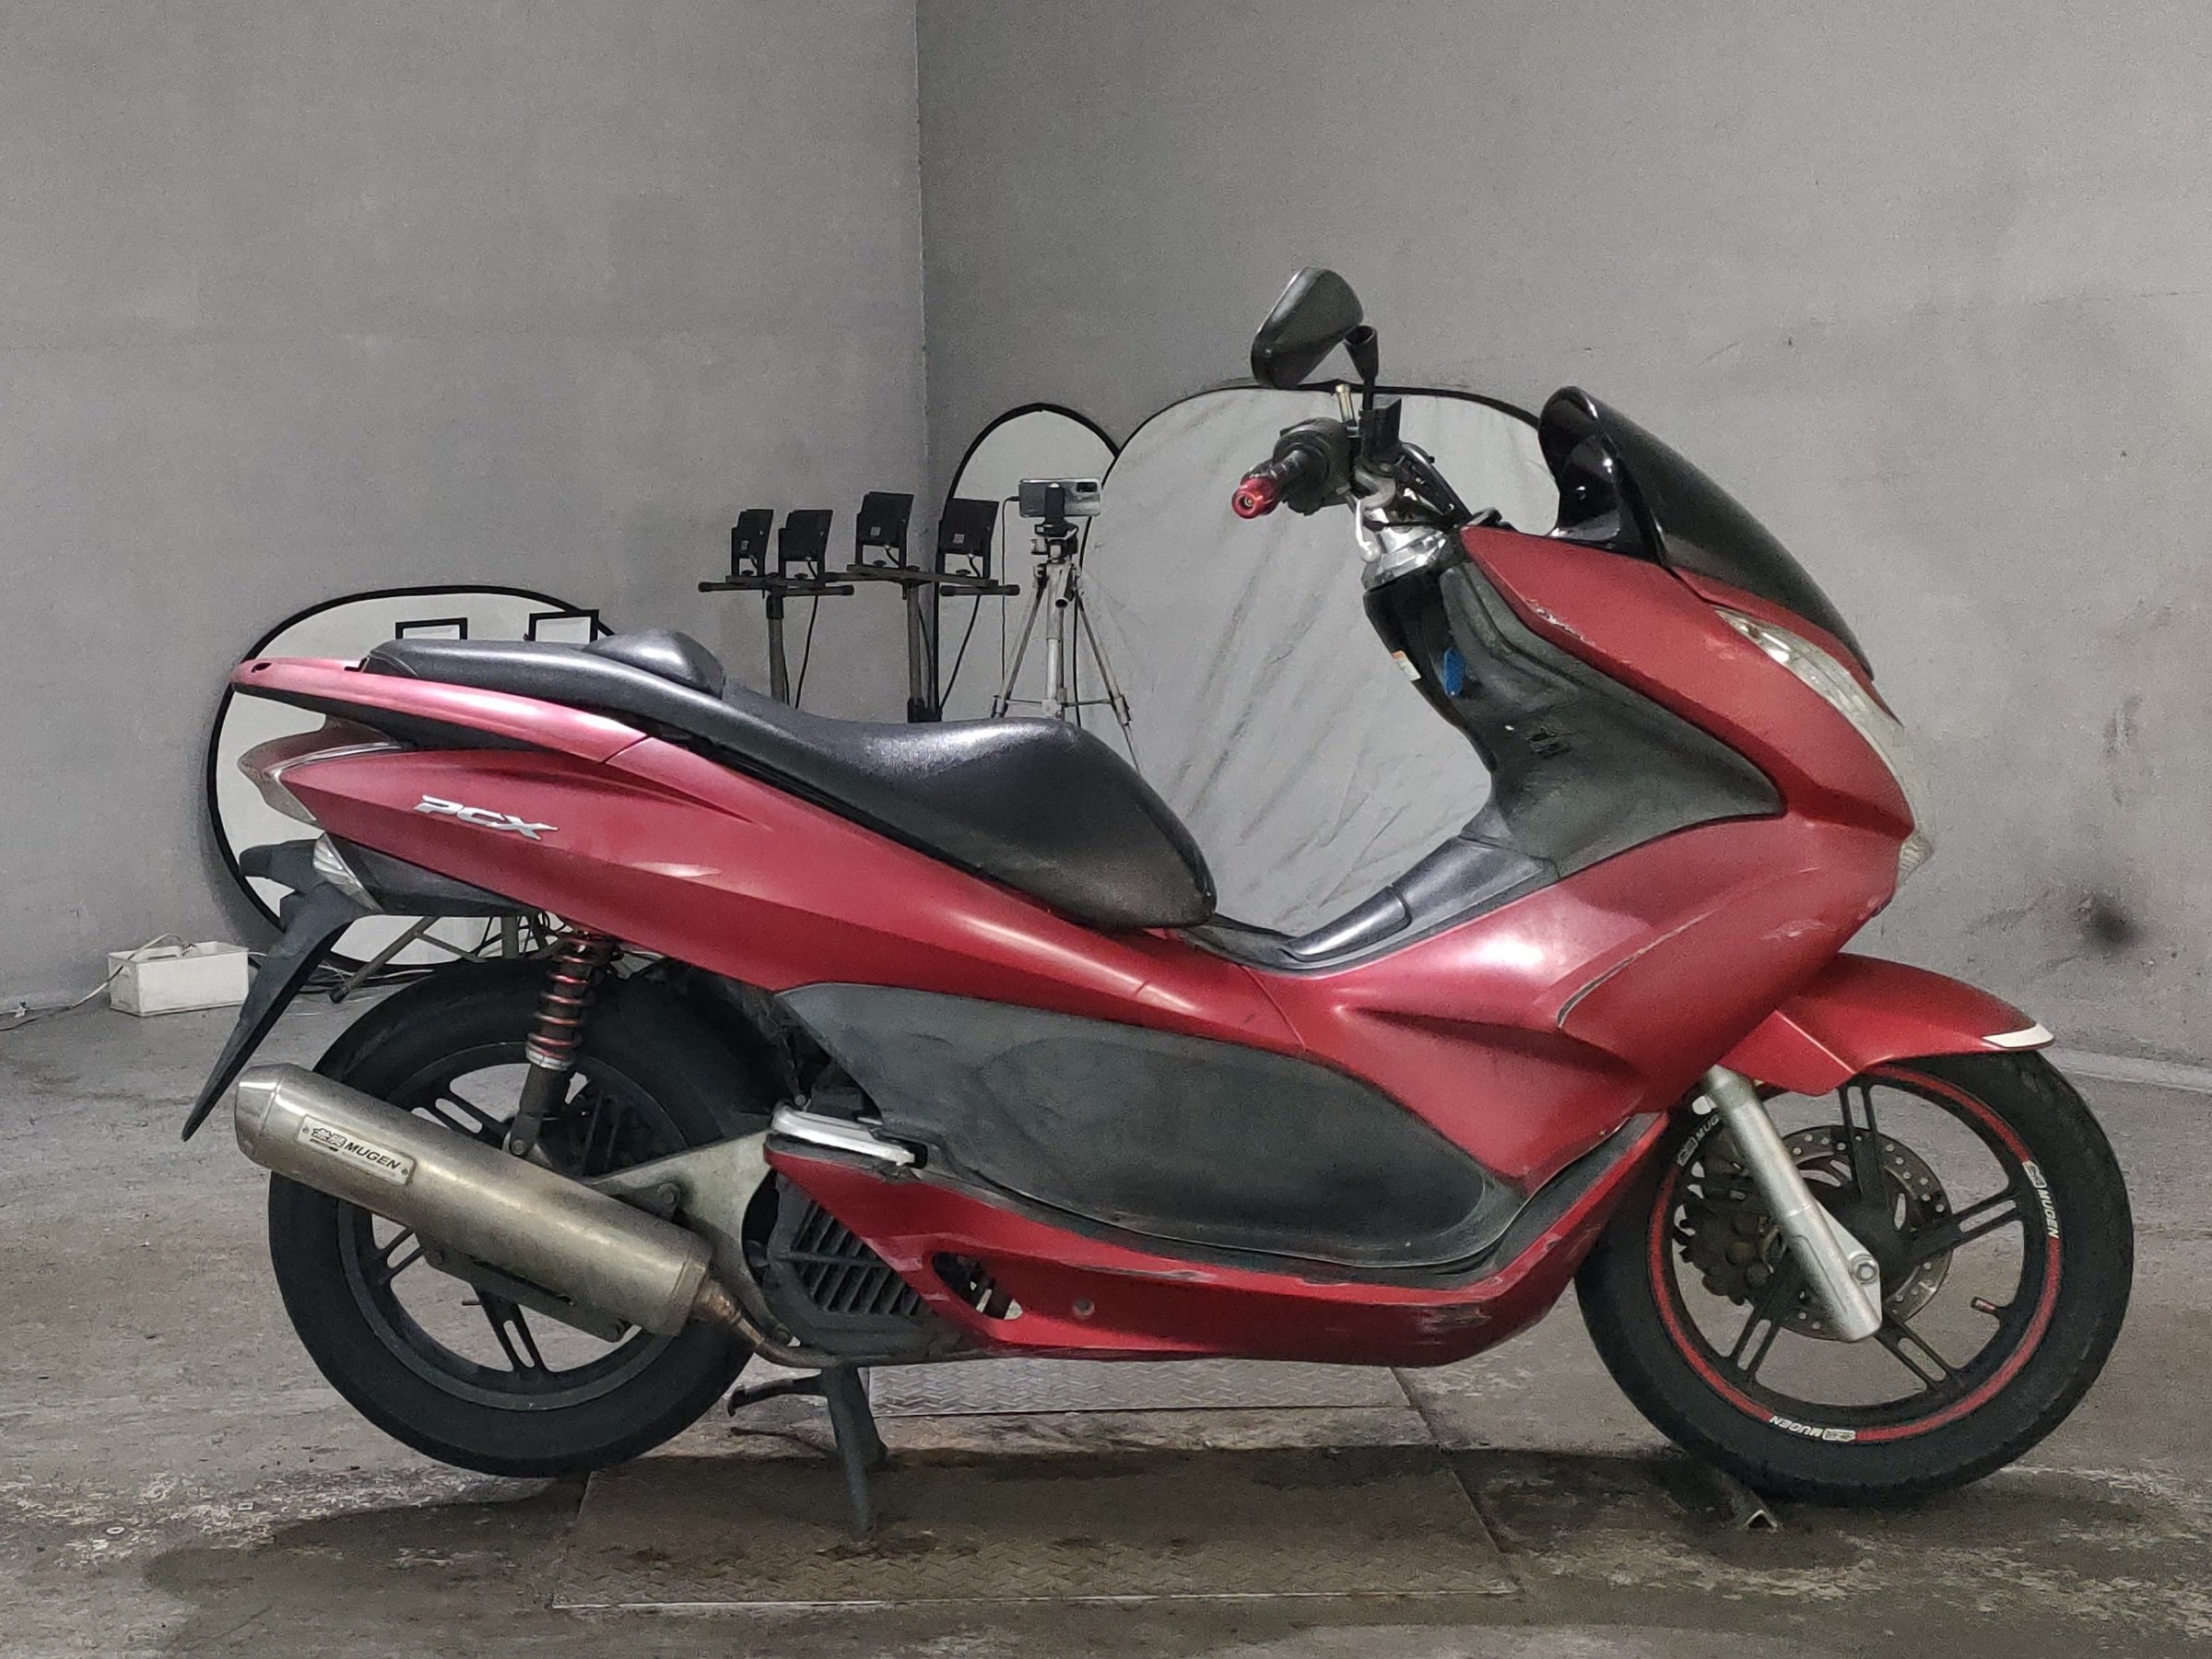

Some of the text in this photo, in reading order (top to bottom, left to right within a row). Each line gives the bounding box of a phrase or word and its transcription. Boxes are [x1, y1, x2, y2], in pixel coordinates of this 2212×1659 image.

[414, 794, 559, 841] PCX
[1696, 1113, 1720, 1141] MUG
[344, 1142, 401, 1170] MUGEN
[2037, 1189, 2060, 1239] MUGEN
[1770, 1415, 1823, 1437] MUGEN
